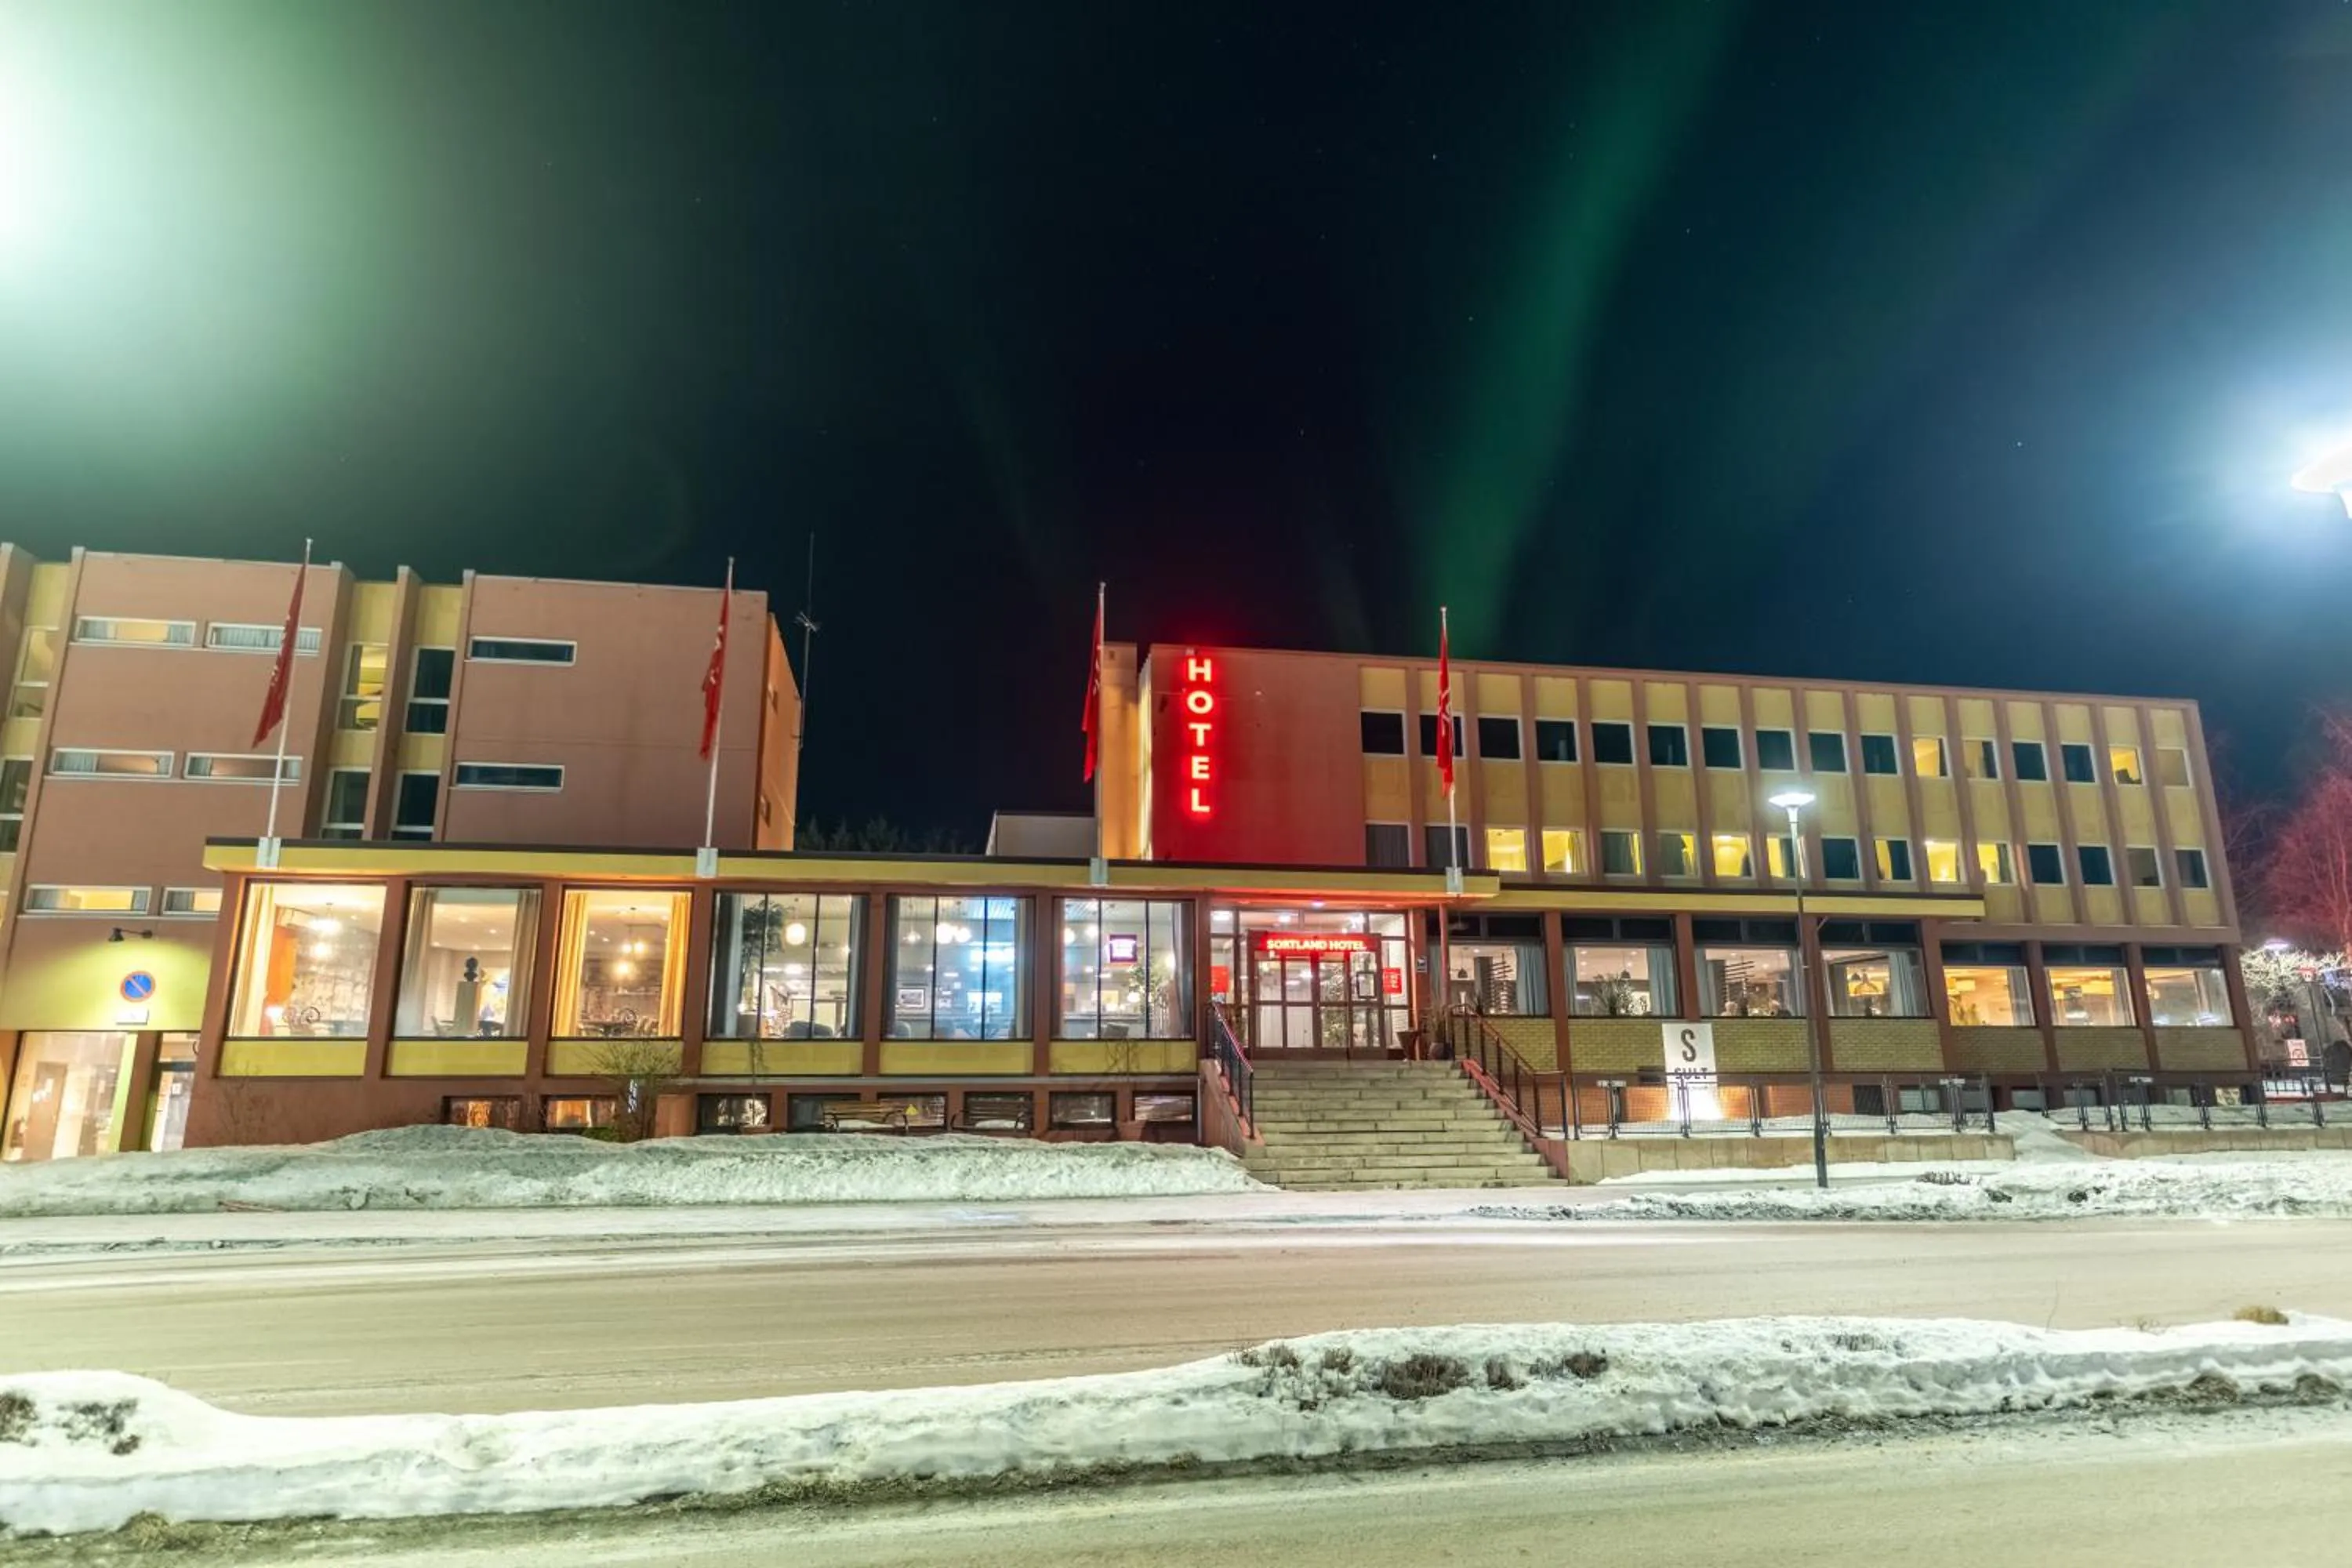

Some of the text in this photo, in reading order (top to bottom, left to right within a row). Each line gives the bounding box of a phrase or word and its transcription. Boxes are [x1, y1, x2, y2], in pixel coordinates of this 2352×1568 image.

[1187, 658, 1213, 813] HOTEL
[1267, 939, 1367, 951] SORTLAND HOTEL
[1680, 1029, 1696, 1062] S
